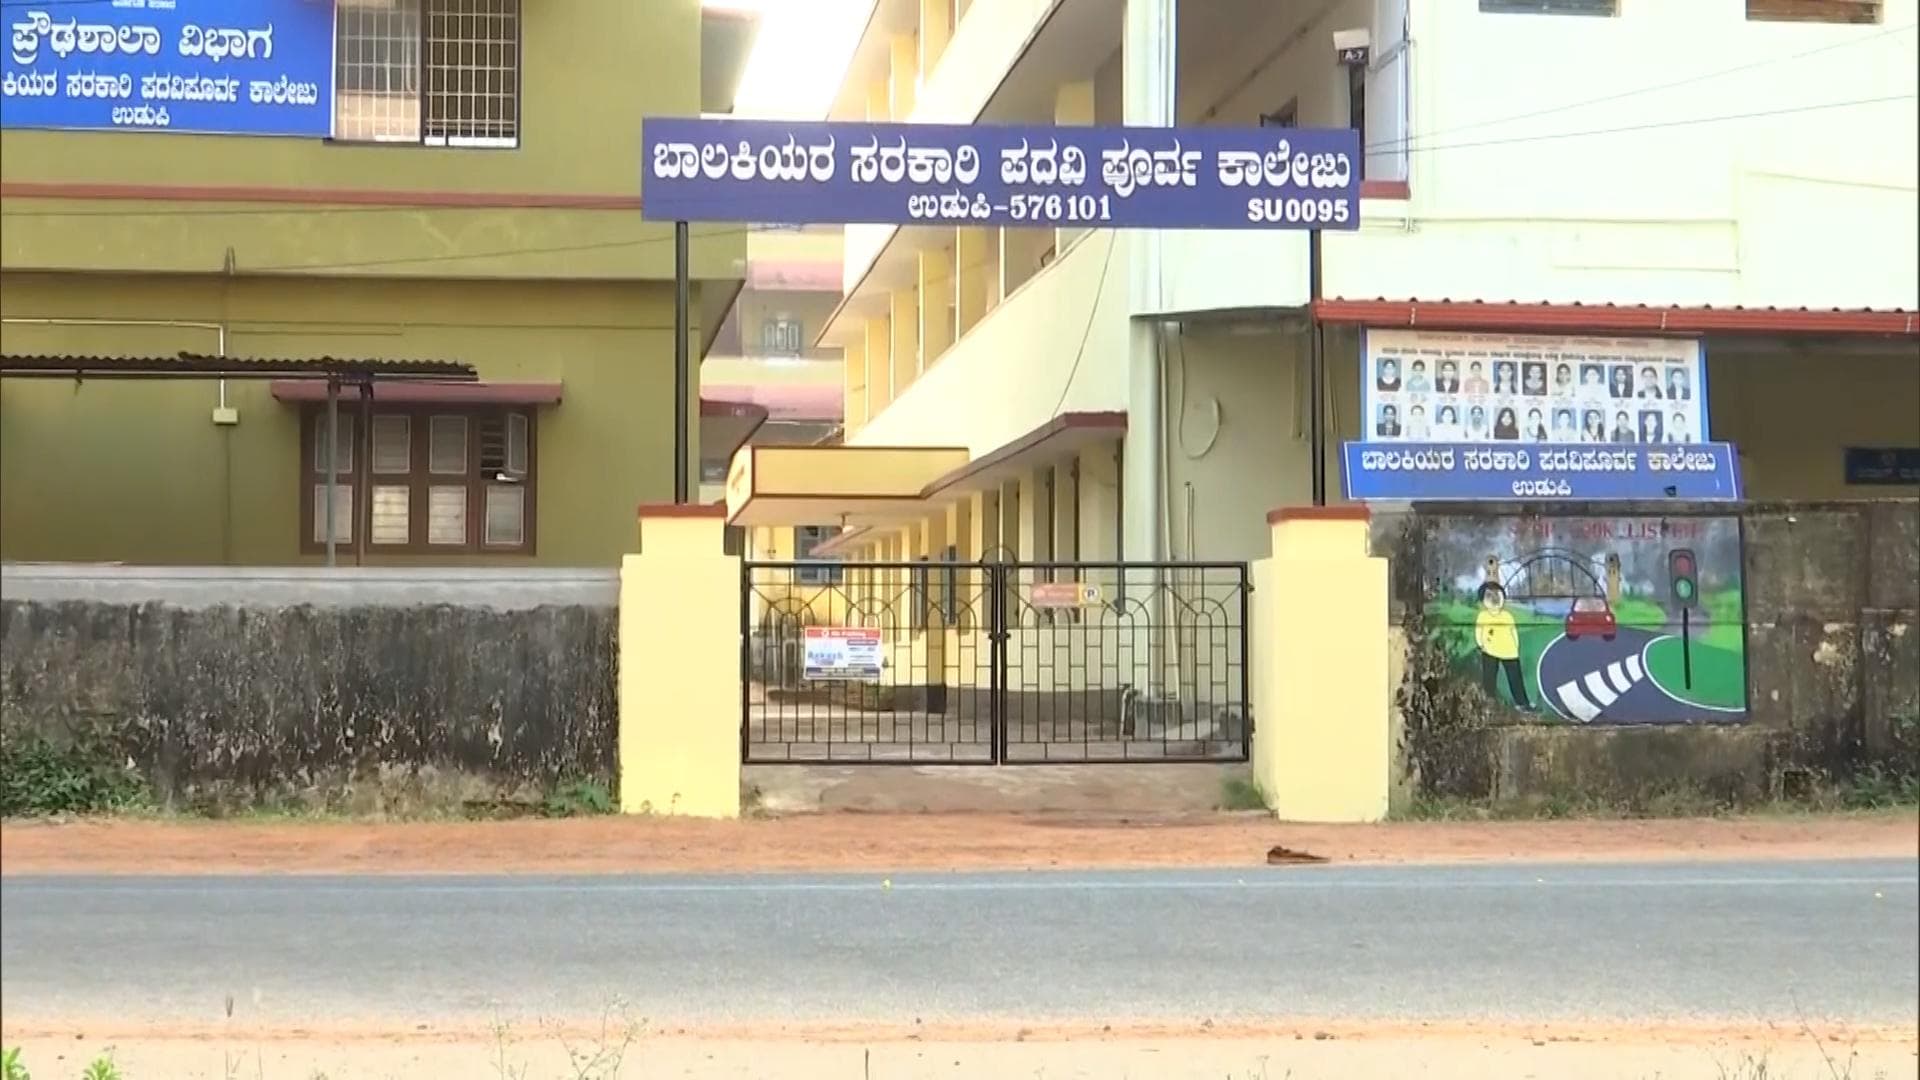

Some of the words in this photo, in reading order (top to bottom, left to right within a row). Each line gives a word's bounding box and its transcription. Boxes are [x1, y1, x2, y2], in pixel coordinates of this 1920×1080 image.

[12, 11, 161, 65] ಪ್ರೌಢಶಾಲಾ
[178, 23, 273, 63] ವಿಭಾಗ
[66, 68, 133, 99] ಸರಕಾರಿ
[141, 71, 240, 102] ಪದವಿಪೂರ್ವ
[249, 74, 318, 105] ಕಾಲೇಜು
[112, 104, 170, 126] ಉಡುಪಿ
[653, 132, 836, 182] ಬಾಲಕಿಯರ
[851, 134, 981, 185] ಸರಕಾರಿ
[1000, 137, 1087, 186] ಪದವಿ
[1101, 137, 1202, 198] ಪೂರ್ವ
[1217, 139, 1350, 189] ಕಾಲೇಜು
[907, 187, 1112, 220] ಉಡುಪಿ-576101
[1361, 447, 1456, 471] ಬಾಲಕಿಯರ
[1464, 447, 1531, 472] ಸರಕಾರಿ
[1539, 449, 1637, 472] ಪದವಿಪೂರ್ವ
[1648, 447, 1717, 472] ಕಾಲೇಜು
[1511, 477, 1572, 497] ಉಡುಪಿ
